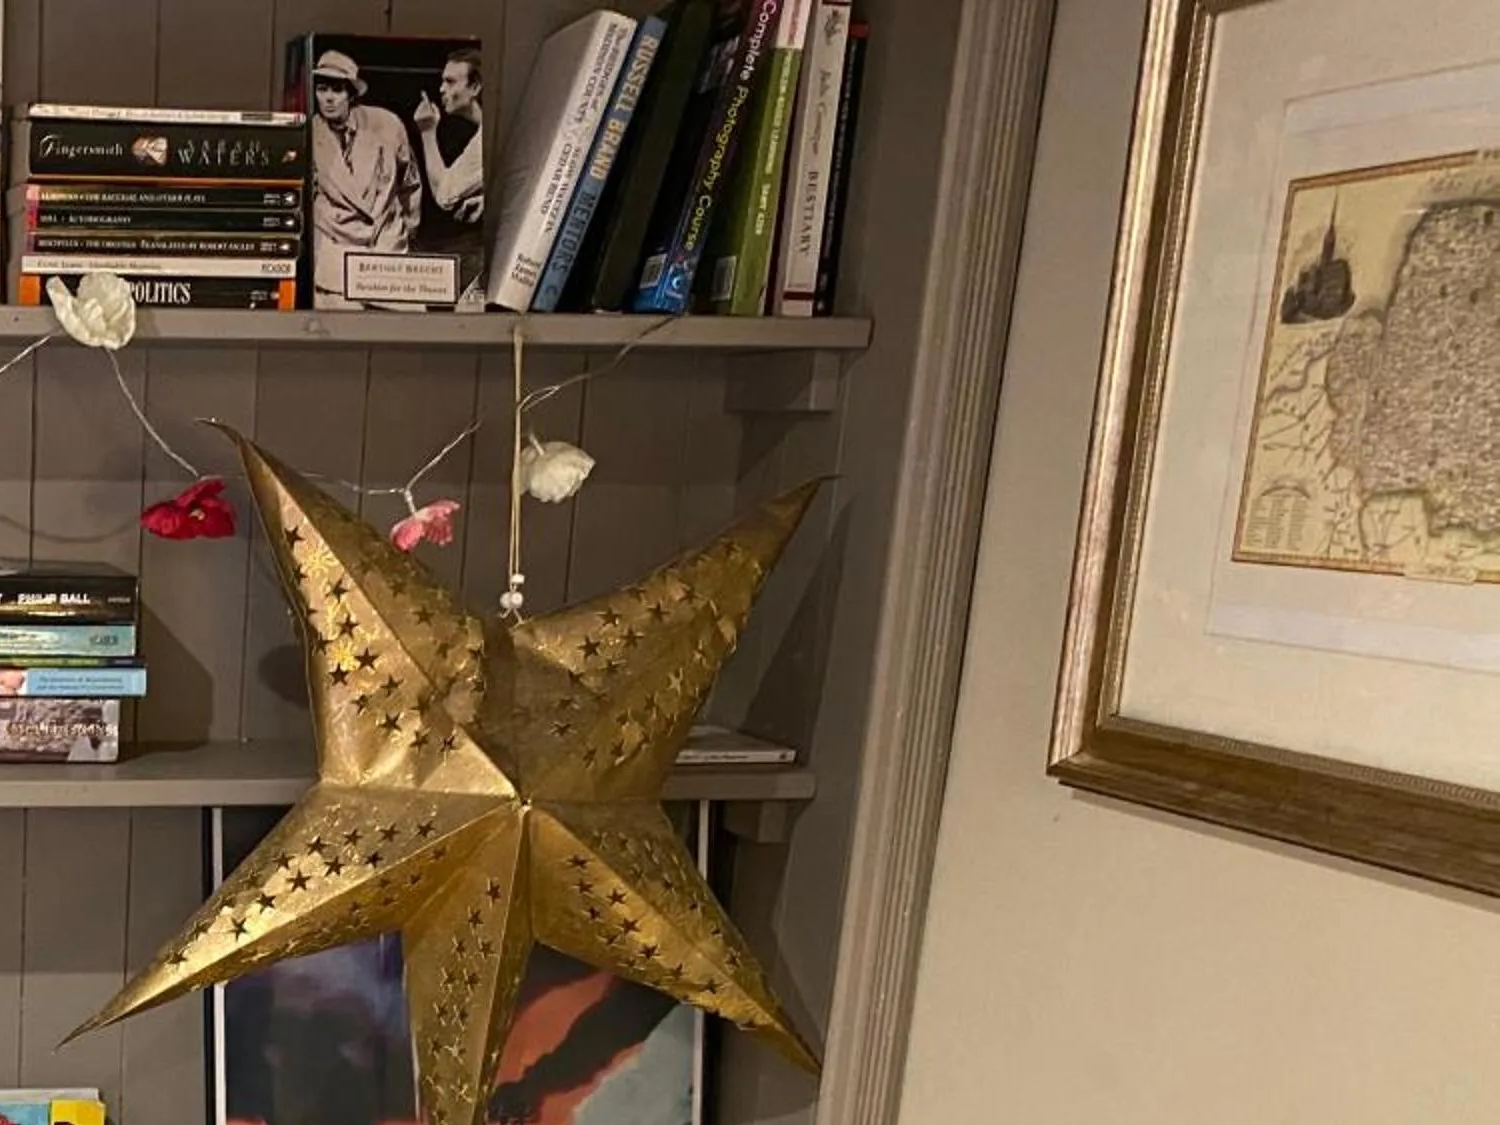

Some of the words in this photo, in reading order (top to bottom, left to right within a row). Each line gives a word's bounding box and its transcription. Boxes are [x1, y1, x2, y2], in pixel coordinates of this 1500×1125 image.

[738, 0, 775, 82] Complete
[613, 33, 658, 114] RUSSELL
[40, 134, 123, 157] Fingersmith
[178, 148, 270, 166] WATERS
[588, 117, 625, 180] BRAND
[700, 83, 748, 192] Photography
[551, 190, 595, 275] MENTORS
[683, 193, 712, 252] Course
[798, 170, 818, 254] BESTIARY
[130, 281, 191, 304] POLITICS
[60, 593, 91, 604] BALL
